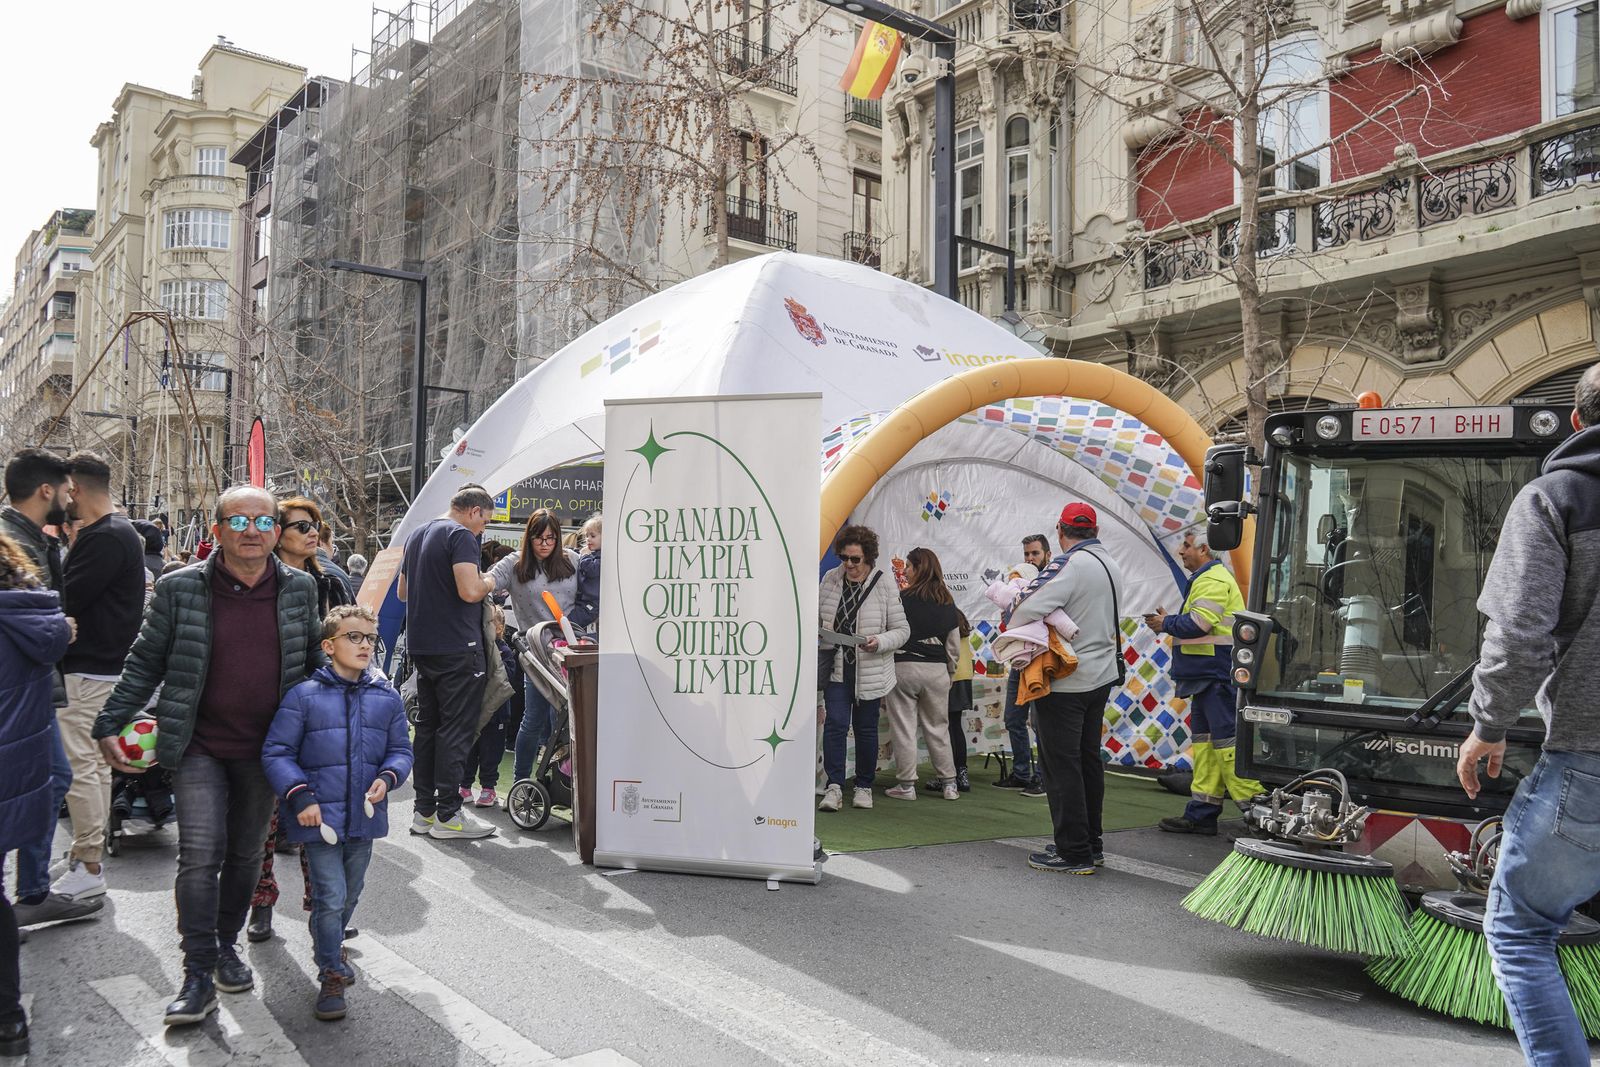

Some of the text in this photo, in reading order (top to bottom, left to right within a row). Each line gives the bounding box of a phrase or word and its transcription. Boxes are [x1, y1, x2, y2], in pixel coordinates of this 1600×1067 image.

[1455, 414, 1500, 434] BHH
[512, 478, 570, 490] ARMACIA
[511, 494, 563, 510] ÓPTICA
[625, 506, 763, 543] GRANADA
[653, 544, 754, 580] LIMPIA
[642, 582, 740, 621] QUE TE
[656, 620, 768, 658] QUIERO
[673, 658, 779, 696] LIMPIA
[1395, 740, 1463, 759] schmi
[767, 816, 797, 829] inagra
